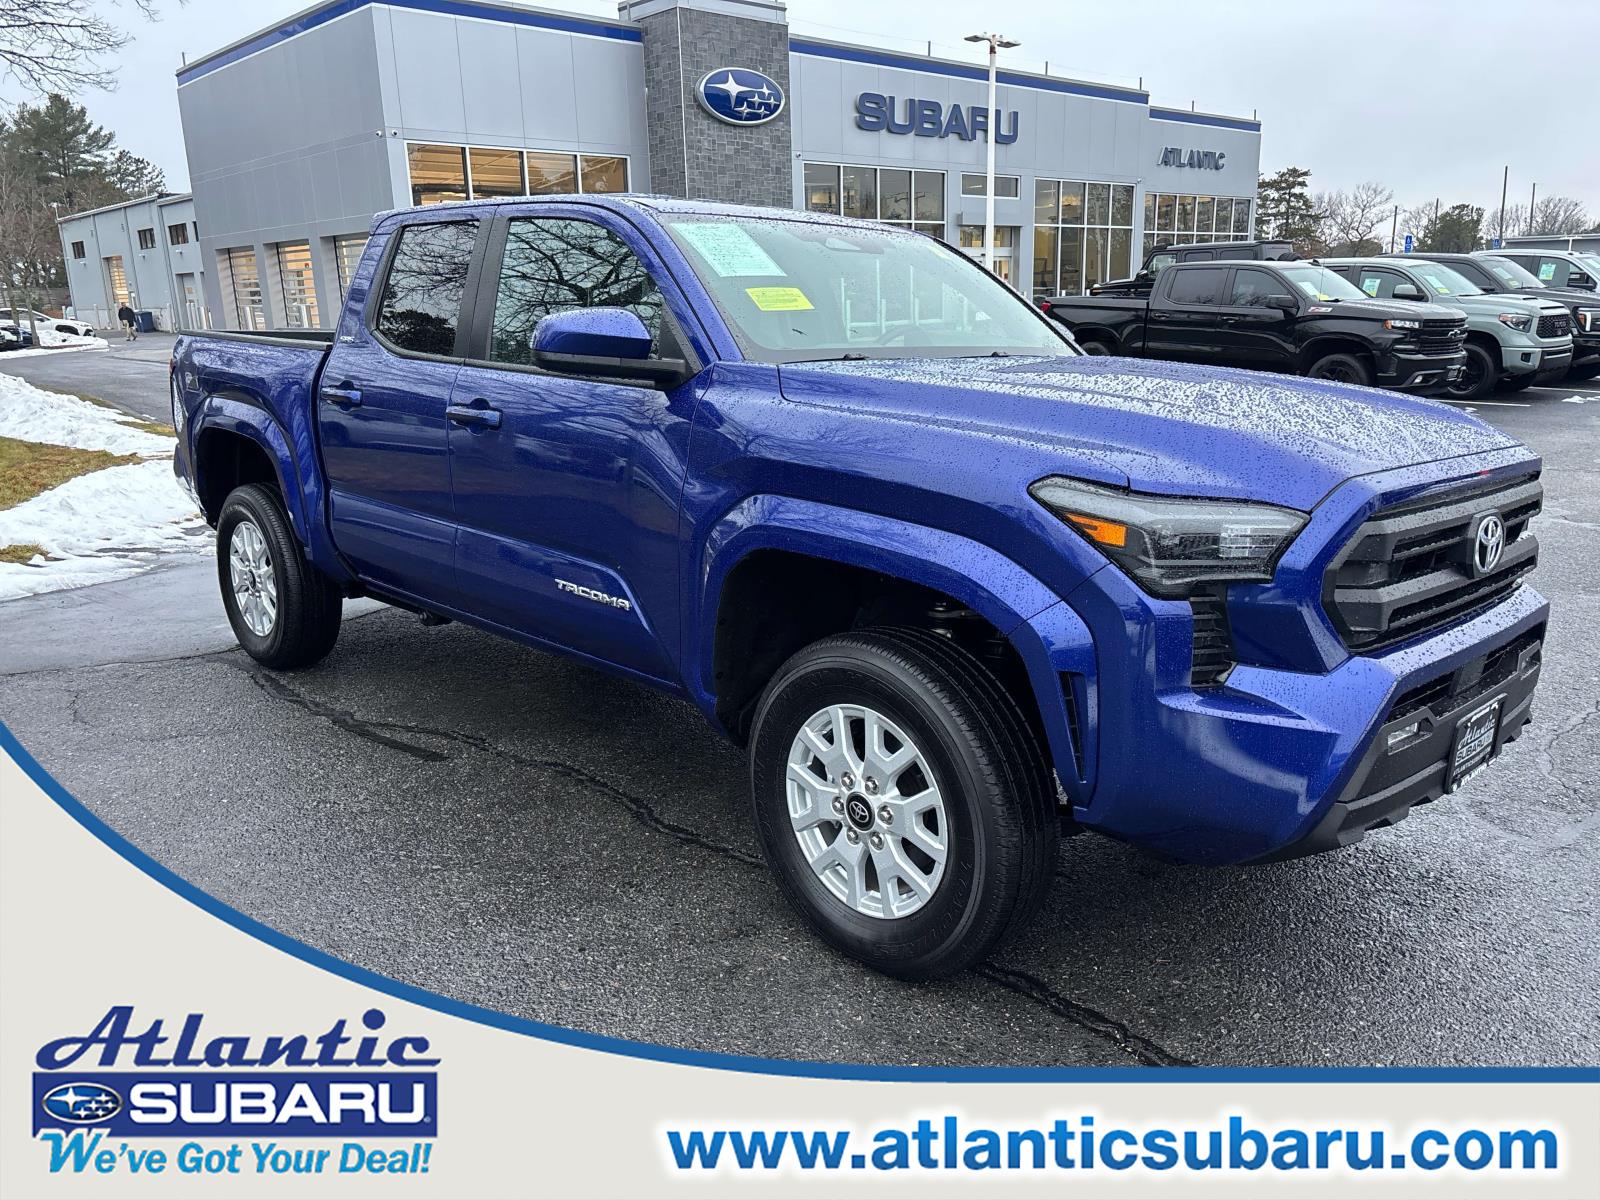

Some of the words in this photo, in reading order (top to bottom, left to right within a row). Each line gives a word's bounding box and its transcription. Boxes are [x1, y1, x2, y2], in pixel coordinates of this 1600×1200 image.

[856, 92, 1019, 144] SUBARU
[1157, 147, 1226, 171] ATLANTIC
[554, 578, 632, 611] TACOMA
